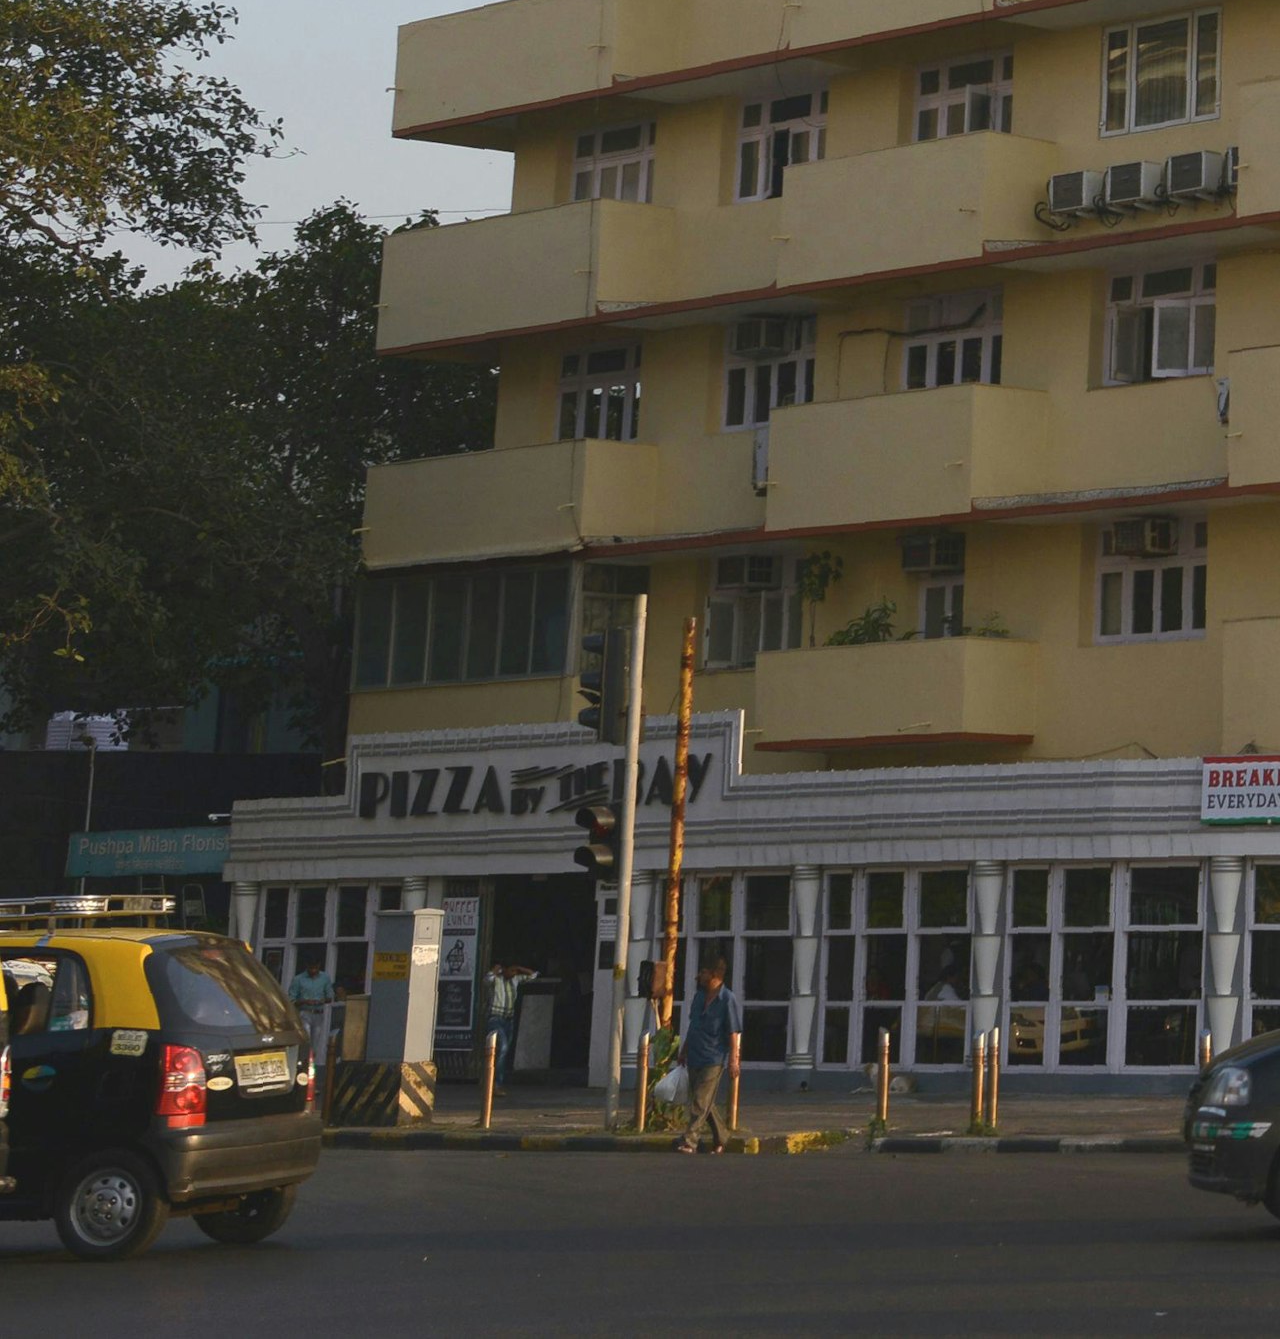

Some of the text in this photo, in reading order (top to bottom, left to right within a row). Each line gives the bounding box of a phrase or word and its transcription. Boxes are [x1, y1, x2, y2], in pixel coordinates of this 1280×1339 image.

[359, 753, 713, 819] PIZZA BY THE BAY
[79, 837, 133, 856] Pushpa
[138, 835, 177, 853] Milan
[446, 914, 474, 926] LUNCH
[113, 1043, 141, 1053] 3360
